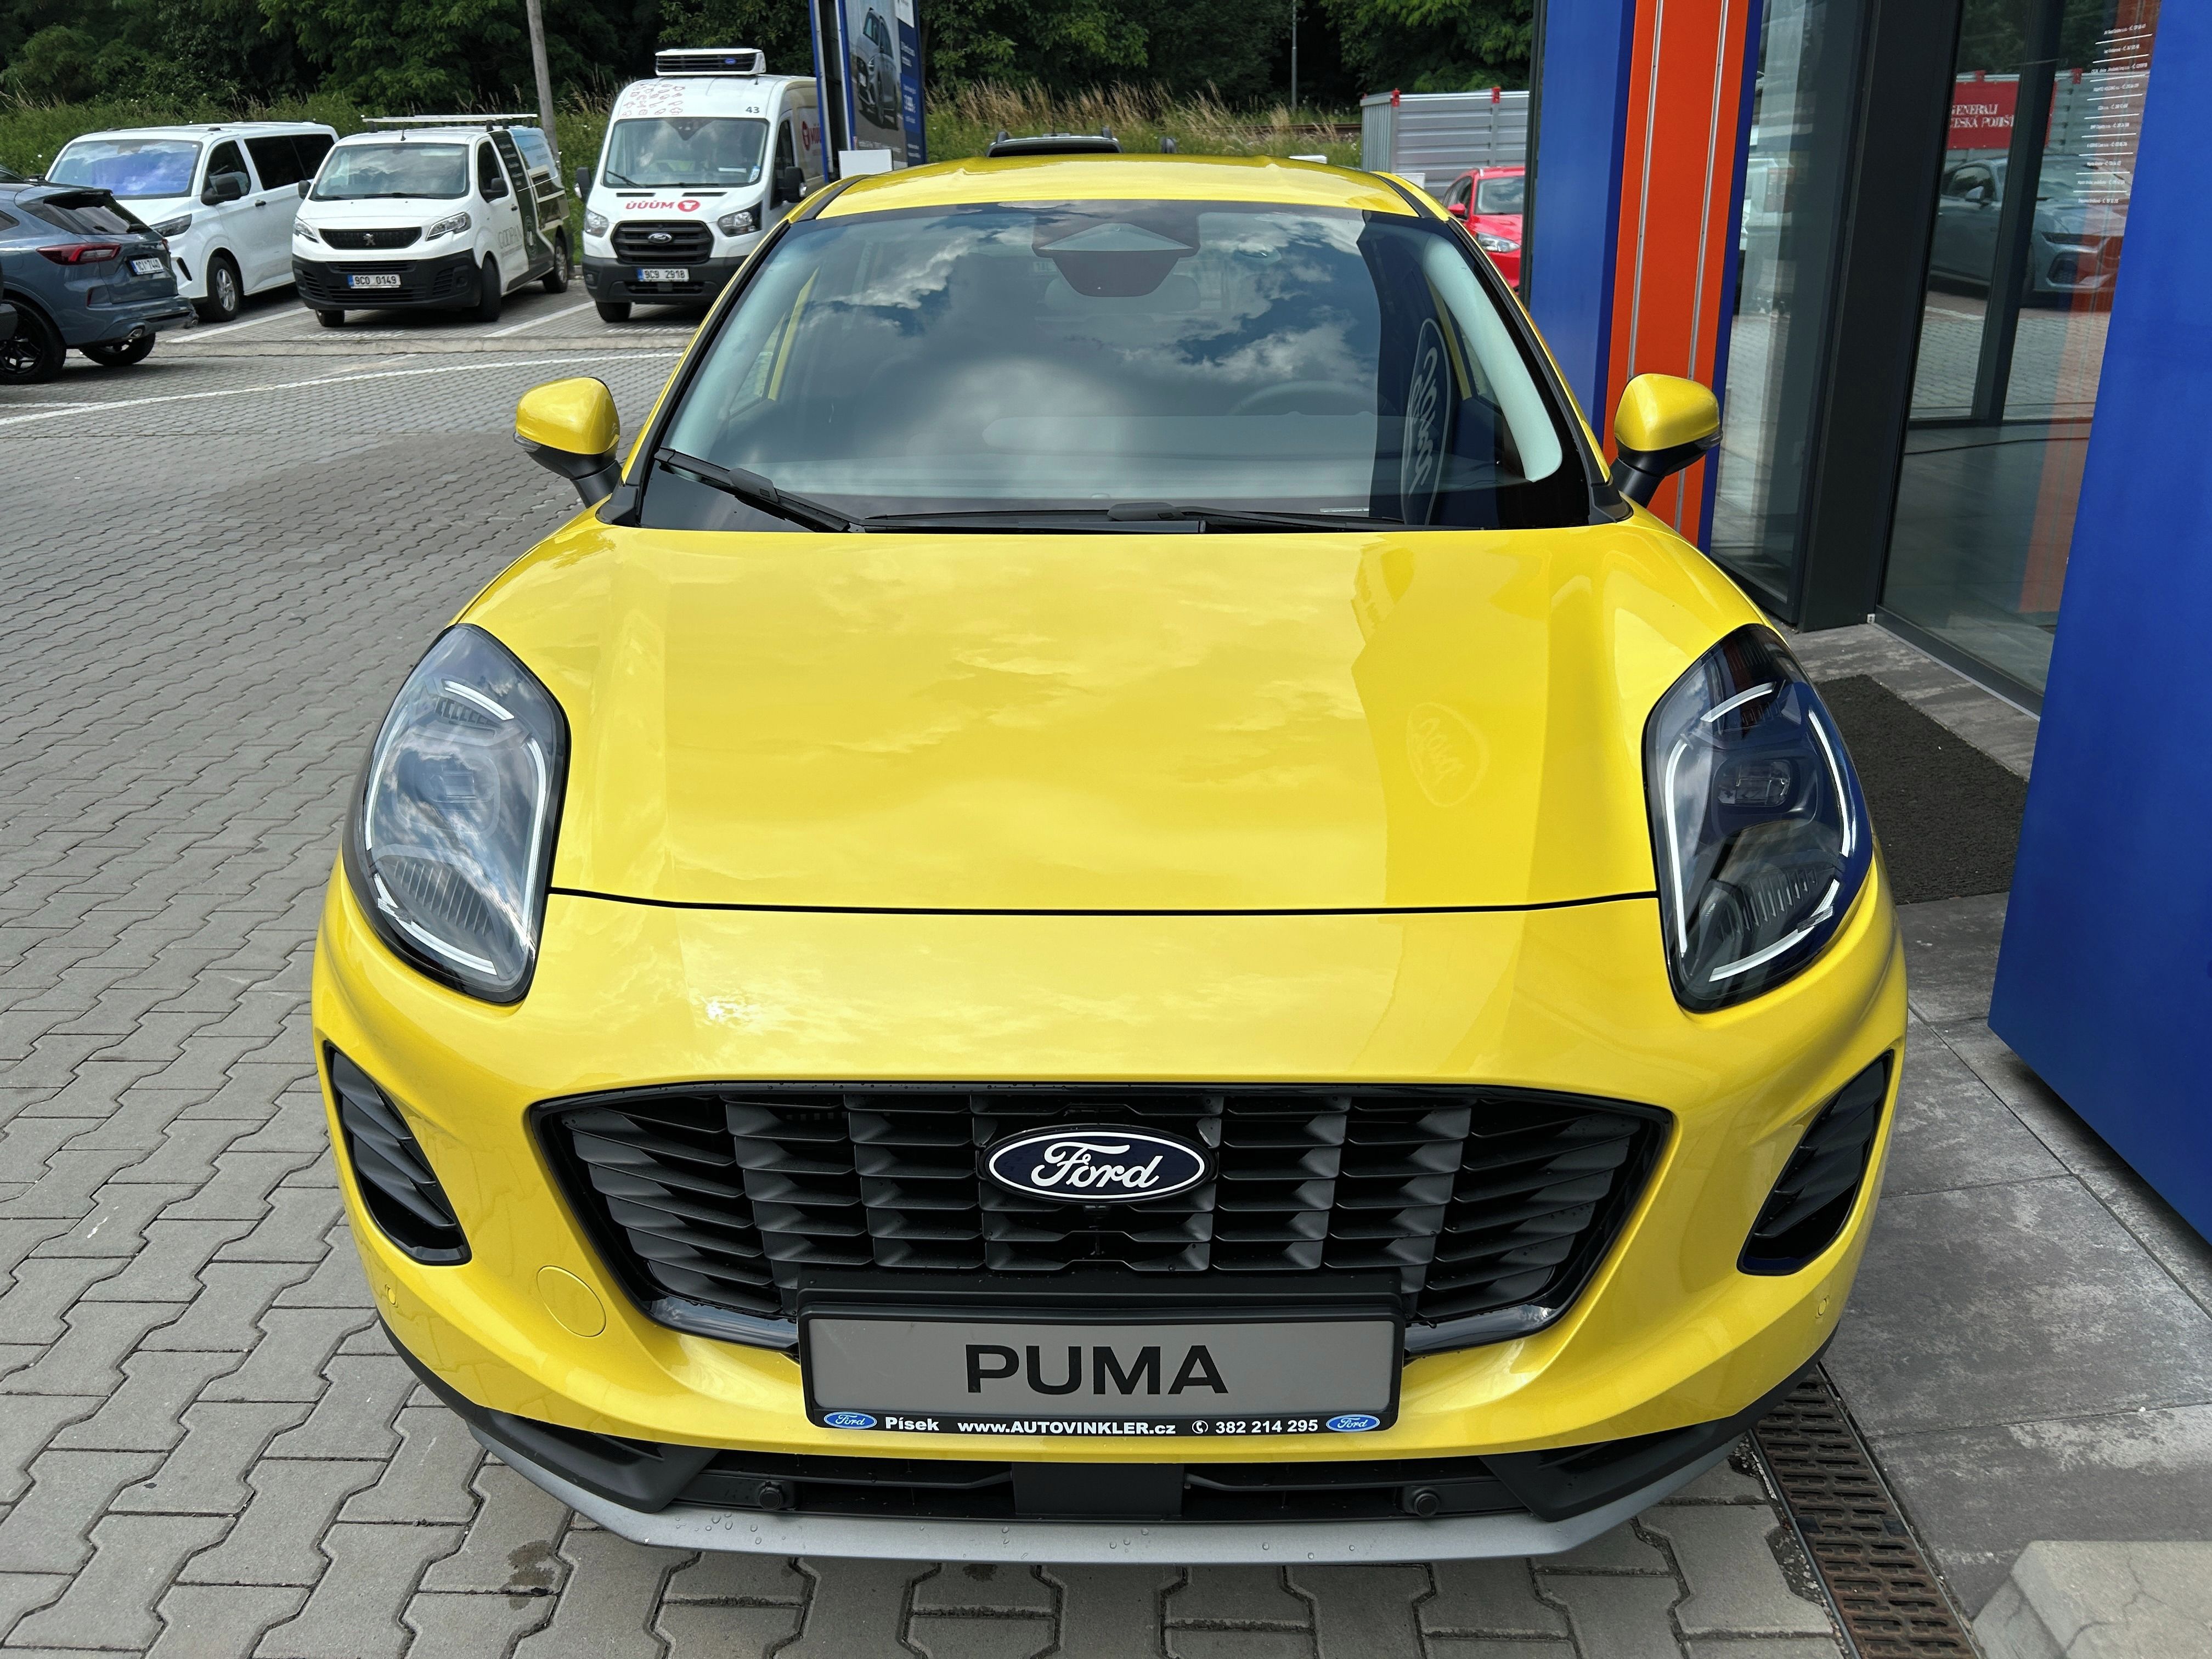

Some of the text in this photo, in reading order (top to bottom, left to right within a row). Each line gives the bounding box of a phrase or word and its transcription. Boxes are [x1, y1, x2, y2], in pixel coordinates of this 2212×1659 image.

[376, 275, 397, 284] 0149
[665, 269, 686, 279] 2918
[1031, 1142, 1164, 1188] Ford
[965, 1344, 1229, 1395] PUMA
[835, 1414, 1368, 1434] Ford Písek www.AUTOVINKLER.cz 382 214 295 Ford
